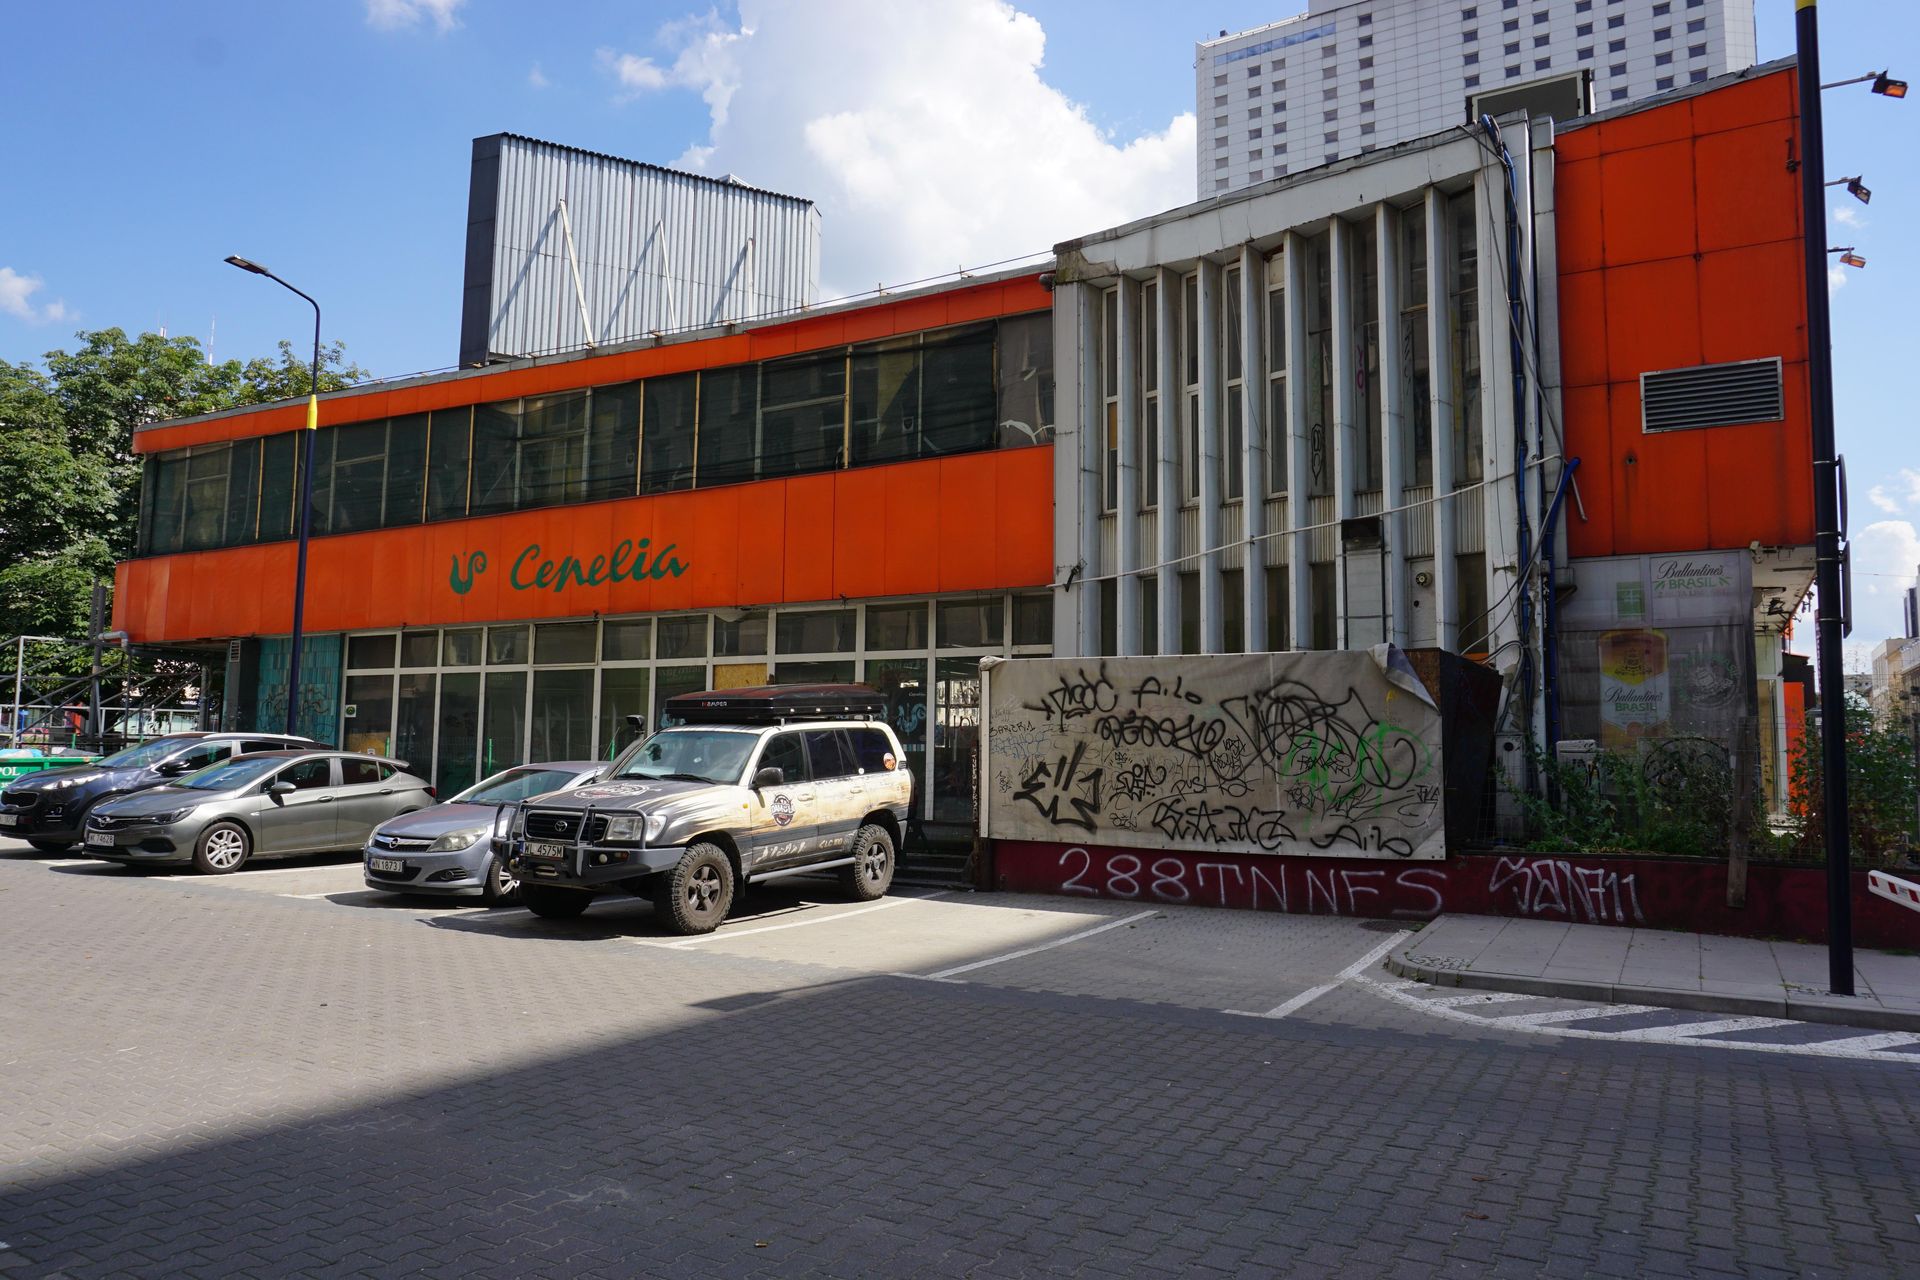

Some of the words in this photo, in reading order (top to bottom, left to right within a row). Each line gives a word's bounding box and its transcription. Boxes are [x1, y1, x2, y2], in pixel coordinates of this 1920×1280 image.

[510, 538, 690, 592] Cepelia
[1657, 560, 1725, 579] Ballantine's
[1668, 577, 1717, 589] BRASIL
[1615, 702, 1657, 712] BRASIL
